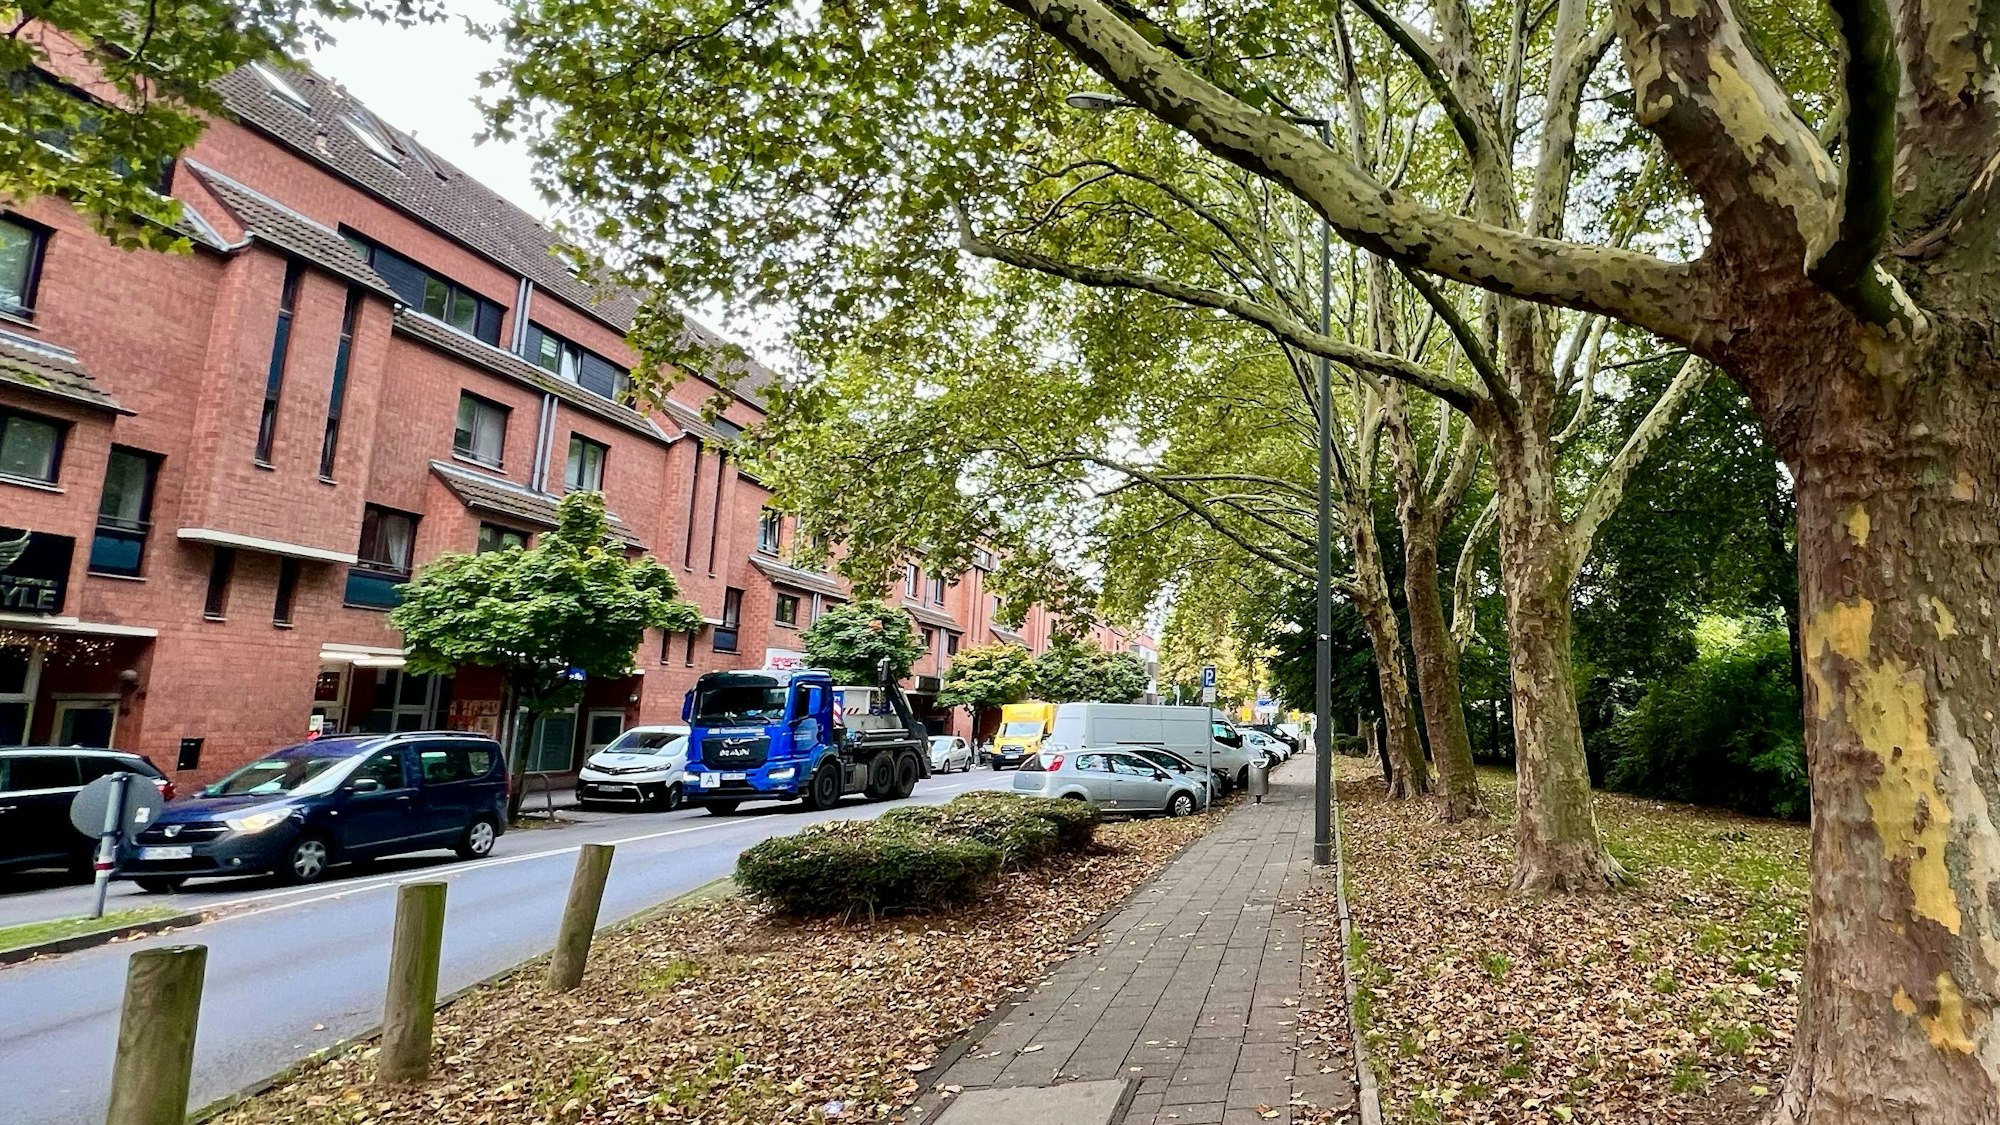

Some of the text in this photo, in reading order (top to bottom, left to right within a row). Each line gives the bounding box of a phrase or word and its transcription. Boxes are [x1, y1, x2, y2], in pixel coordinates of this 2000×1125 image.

[1205, 669, 1213, 686] P
[719, 748, 750, 756] MAN
[705, 775, 714, 785] A
